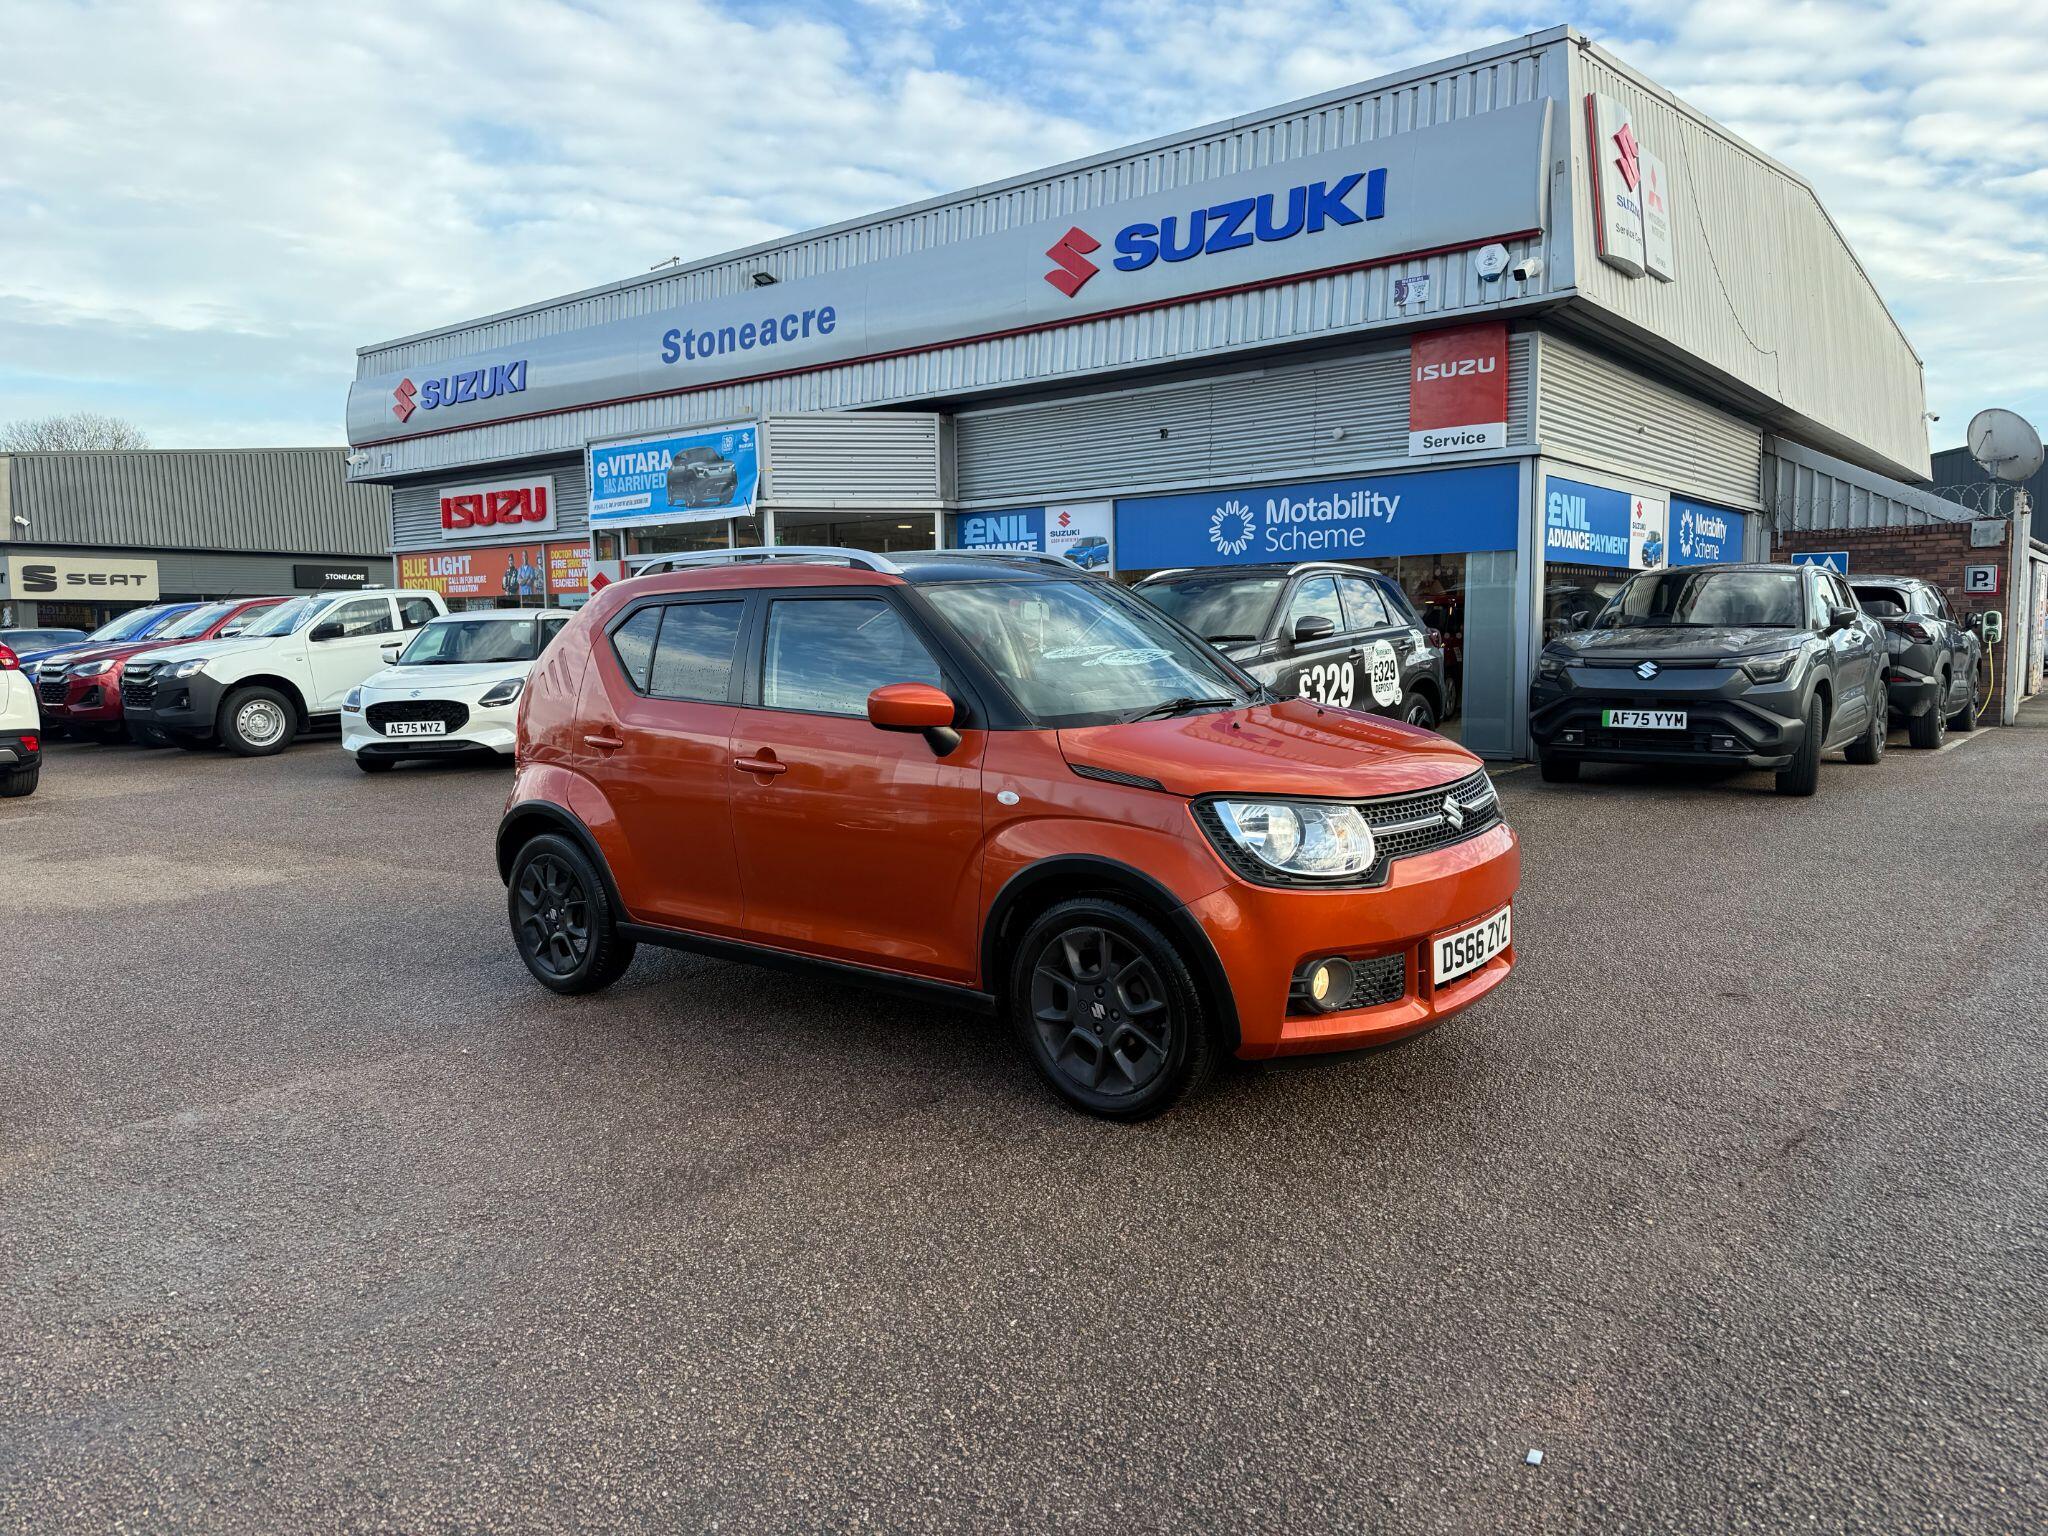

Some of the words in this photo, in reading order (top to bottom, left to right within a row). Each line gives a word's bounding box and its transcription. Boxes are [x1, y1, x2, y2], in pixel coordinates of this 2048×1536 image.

[1113, 168, 1387, 272] SUZUKI
[661, 306, 836, 364] Stoneacre
[1417, 356, 1496, 382] ISUZU
[420, 360, 528, 409] SUZUKI
[1423, 431, 1486, 449] Service
[597, 449, 673, 478] eVITARA
[603, 476, 617, 494] HAS
[617, 472, 667, 493] ARRIVED
[441, 486, 547, 529] ISUZU
[1266, 490, 1400, 523] Motability
[1547, 491, 1590, 531] £NIL
[964, 514, 1038, 545] £NIL
[1050, 528, 1080, 538] SUZUKI
[1265, 526, 1366, 552] Scheme
[1695, 513, 1728, 545] Motability
[550, 550, 573, 559] DOCTOR
[1694, 538, 1720, 561] Scheme
[402, 557, 428, 578] BLUE
[429, 555, 472, 577] LIGHT
[551, 559, 567, 569] FIRE
[552, 569, 568, 579] ARMY
[568, 568, 588, 578] NAVY
[66, 573, 147, 586] SEAT
[403, 577, 448, 593] DISCOUNT
[551, 578, 580, 588] TEACHERS
[1973, 571, 1989, 588] P
[1373, 659, 1396, 683] £329
[1298, 661, 1355, 708] £329
[1375, 683, 1394, 694] DEPOSIT
[390, 723, 418, 734] AE75
[420, 722, 441, 733] MYZ
[1611, 711, 1650, 726] AF75
[1654, 712, 1684, 727] YYM
[1442, 928, 1485, 974] DS66
[1487, 912, 1508, 954] ZYZ
